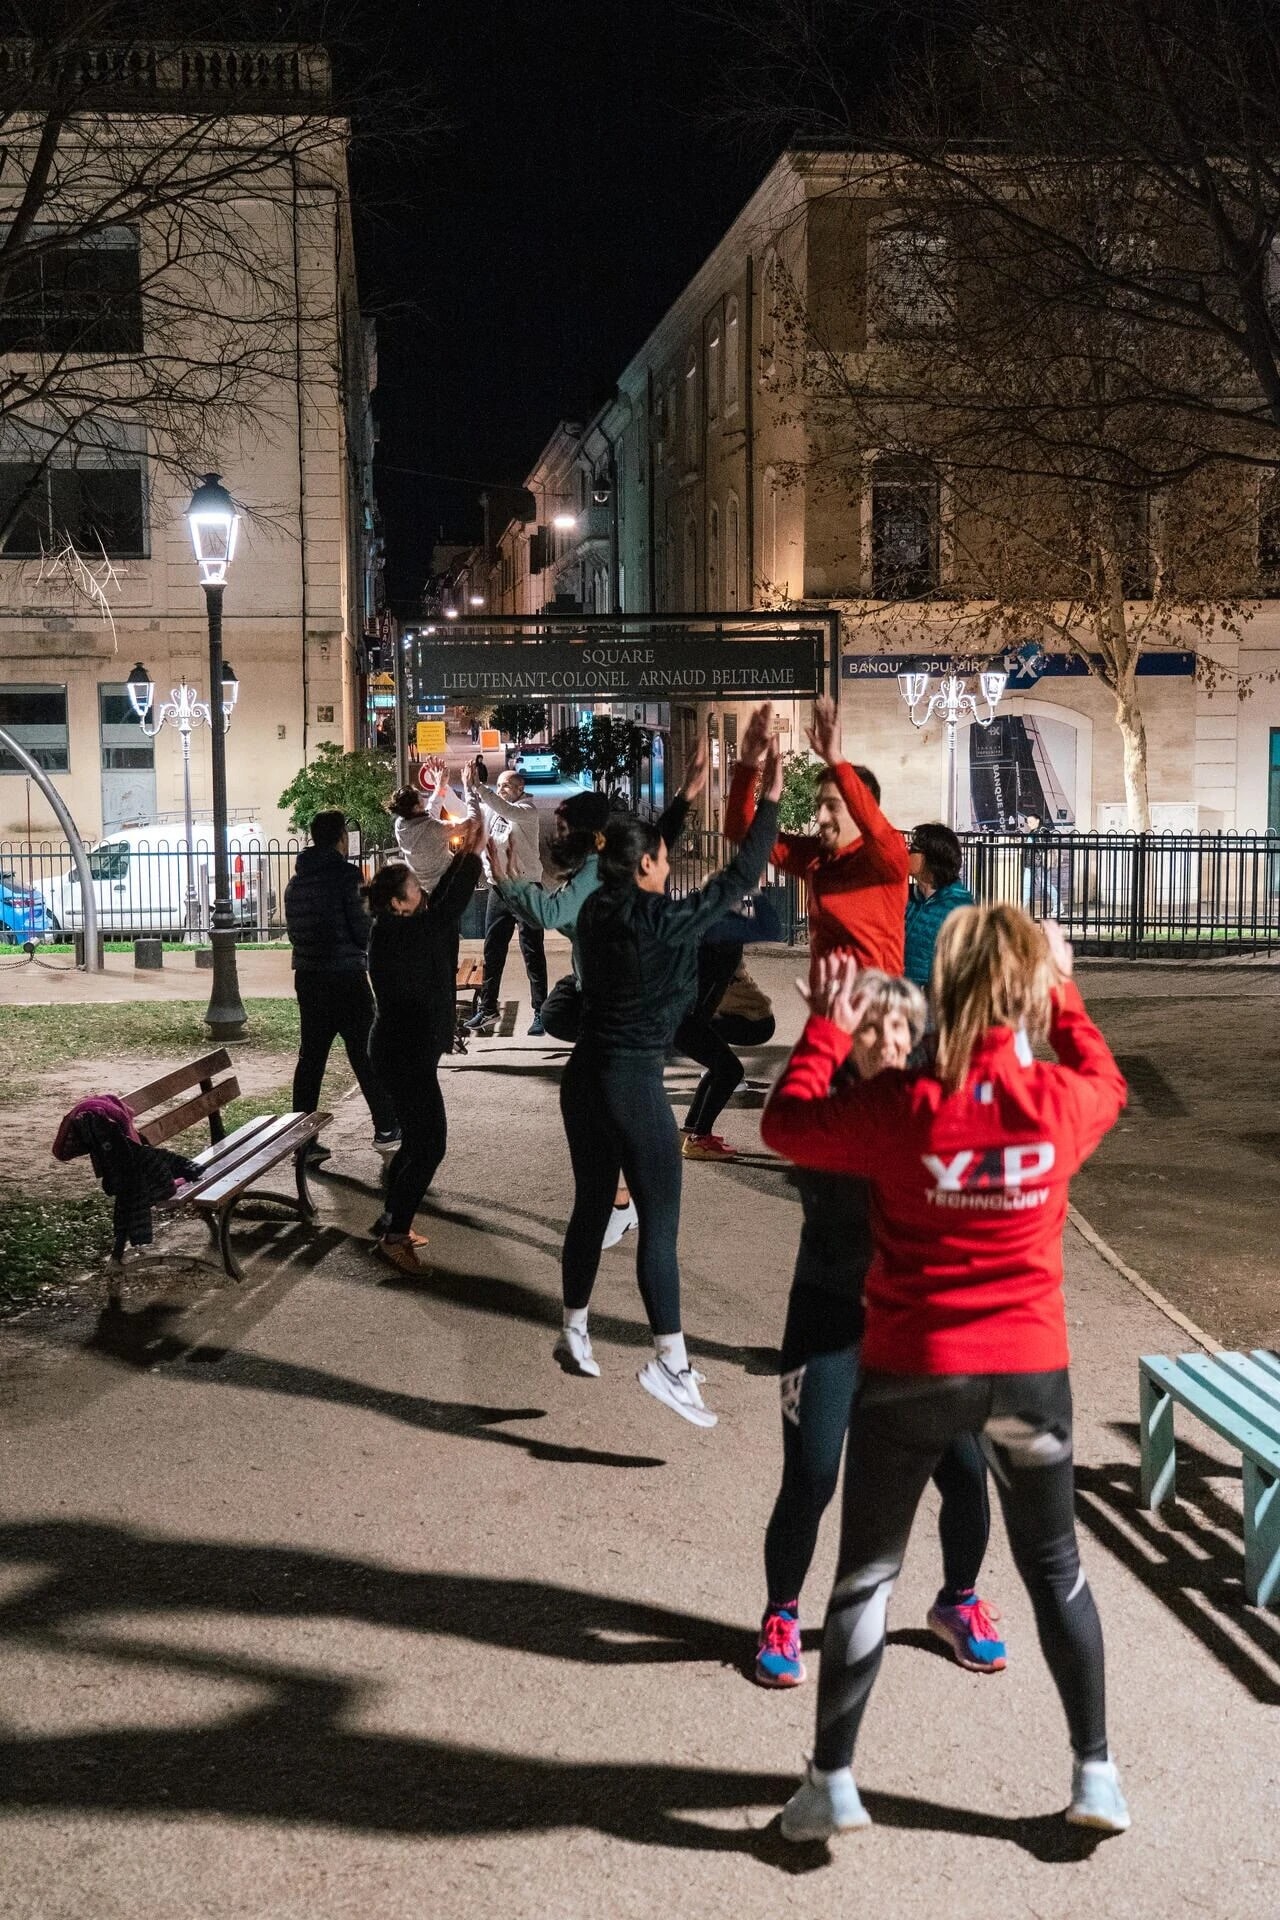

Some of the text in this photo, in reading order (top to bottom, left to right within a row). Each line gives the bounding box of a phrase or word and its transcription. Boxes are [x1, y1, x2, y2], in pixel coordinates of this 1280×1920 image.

[582, 649, 655, 666] SQUARE
[849, 662, 902, 673] BANQU
[442, 668, 795, 689] LIEUTENANT-COLONEL ARNAUD BELTRAME
[992, 764, 1004, 809] BANQUE
[921, 1141, 1056, 1191] YAP
